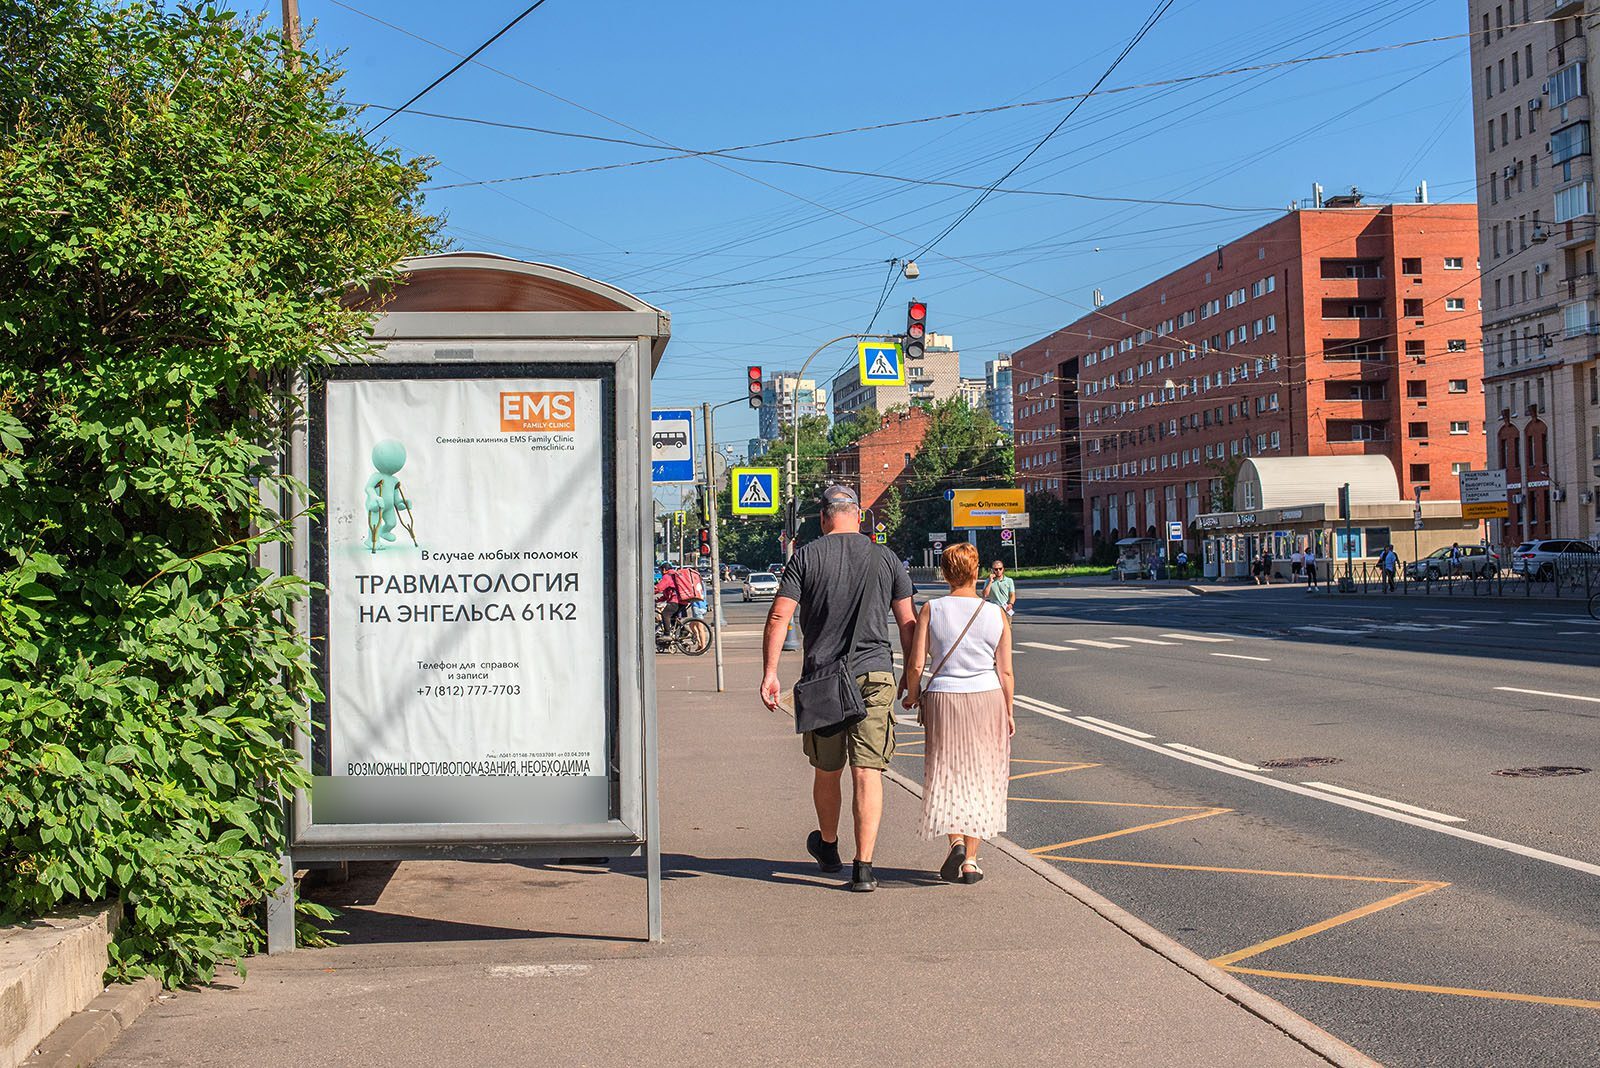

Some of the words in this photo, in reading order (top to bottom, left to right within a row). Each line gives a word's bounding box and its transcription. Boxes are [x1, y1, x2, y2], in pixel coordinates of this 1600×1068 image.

[503, 394, 572, 421] EMS
[436, 436, 475, 444] Семейная
[528, 435, 551, 446] Family
[553, 435, 574, 443] Clinic
[531, 443, 575, 451] emsclinic.ru
[421, 550, 430, 561] В
[433, 552, 475, 564] случае
[478, 549, 520, 560] любых
[523, 551, 579, 560] поломок
[355, 572, 579, 594] ТРАВМАТОЛОГИЯ
[359, 605, 392, 623] НА
[397, 604, 516, 623] ЭНГЕЛЬСА
[521, 602, 577, 622] 61К2
[417, 660, 458, 671] Телефон
[459, 662, 476, 671] для
[480, 661, 520, 671] справок
[417, 686, 432, 697] +7
[434, 685, 465, 697] (812)
[467, 685, 521, 696] 777-7703
[347, 761, 408, 776] ВОЗМОЖНЫ
[409, 760, 520, 776] ПРОТИВОПОКАЗАНИЯ,
[520, 759, 591, 775] НЕОБХОДИМА
